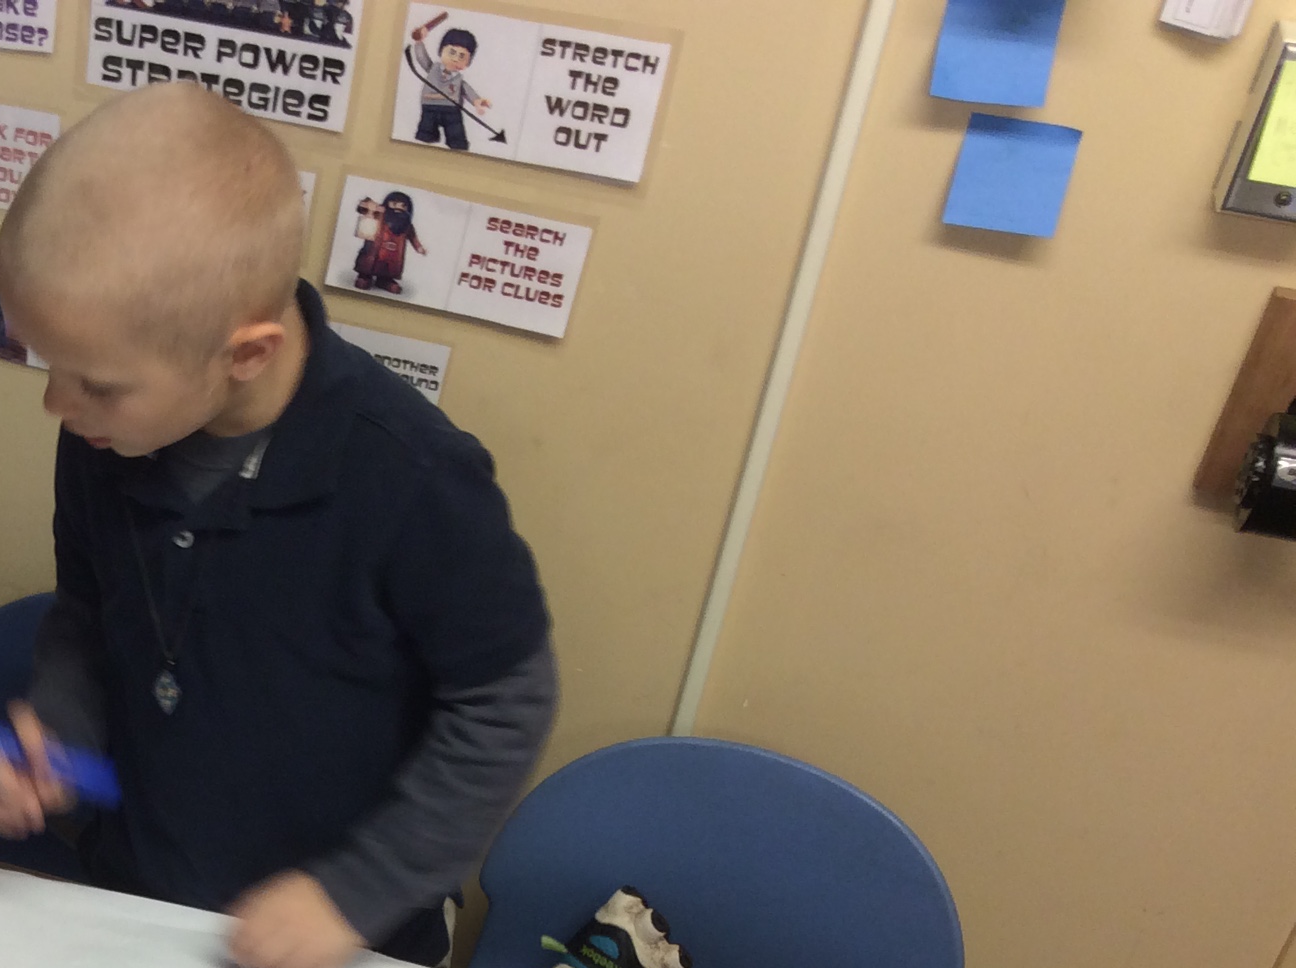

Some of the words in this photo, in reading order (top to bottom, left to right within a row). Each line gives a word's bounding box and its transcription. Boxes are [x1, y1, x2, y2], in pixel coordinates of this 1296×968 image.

[544, 94, 631, 129] WORD
[553, 126, 609, 153] OUT
[457, 271, 498, 294] FOR
